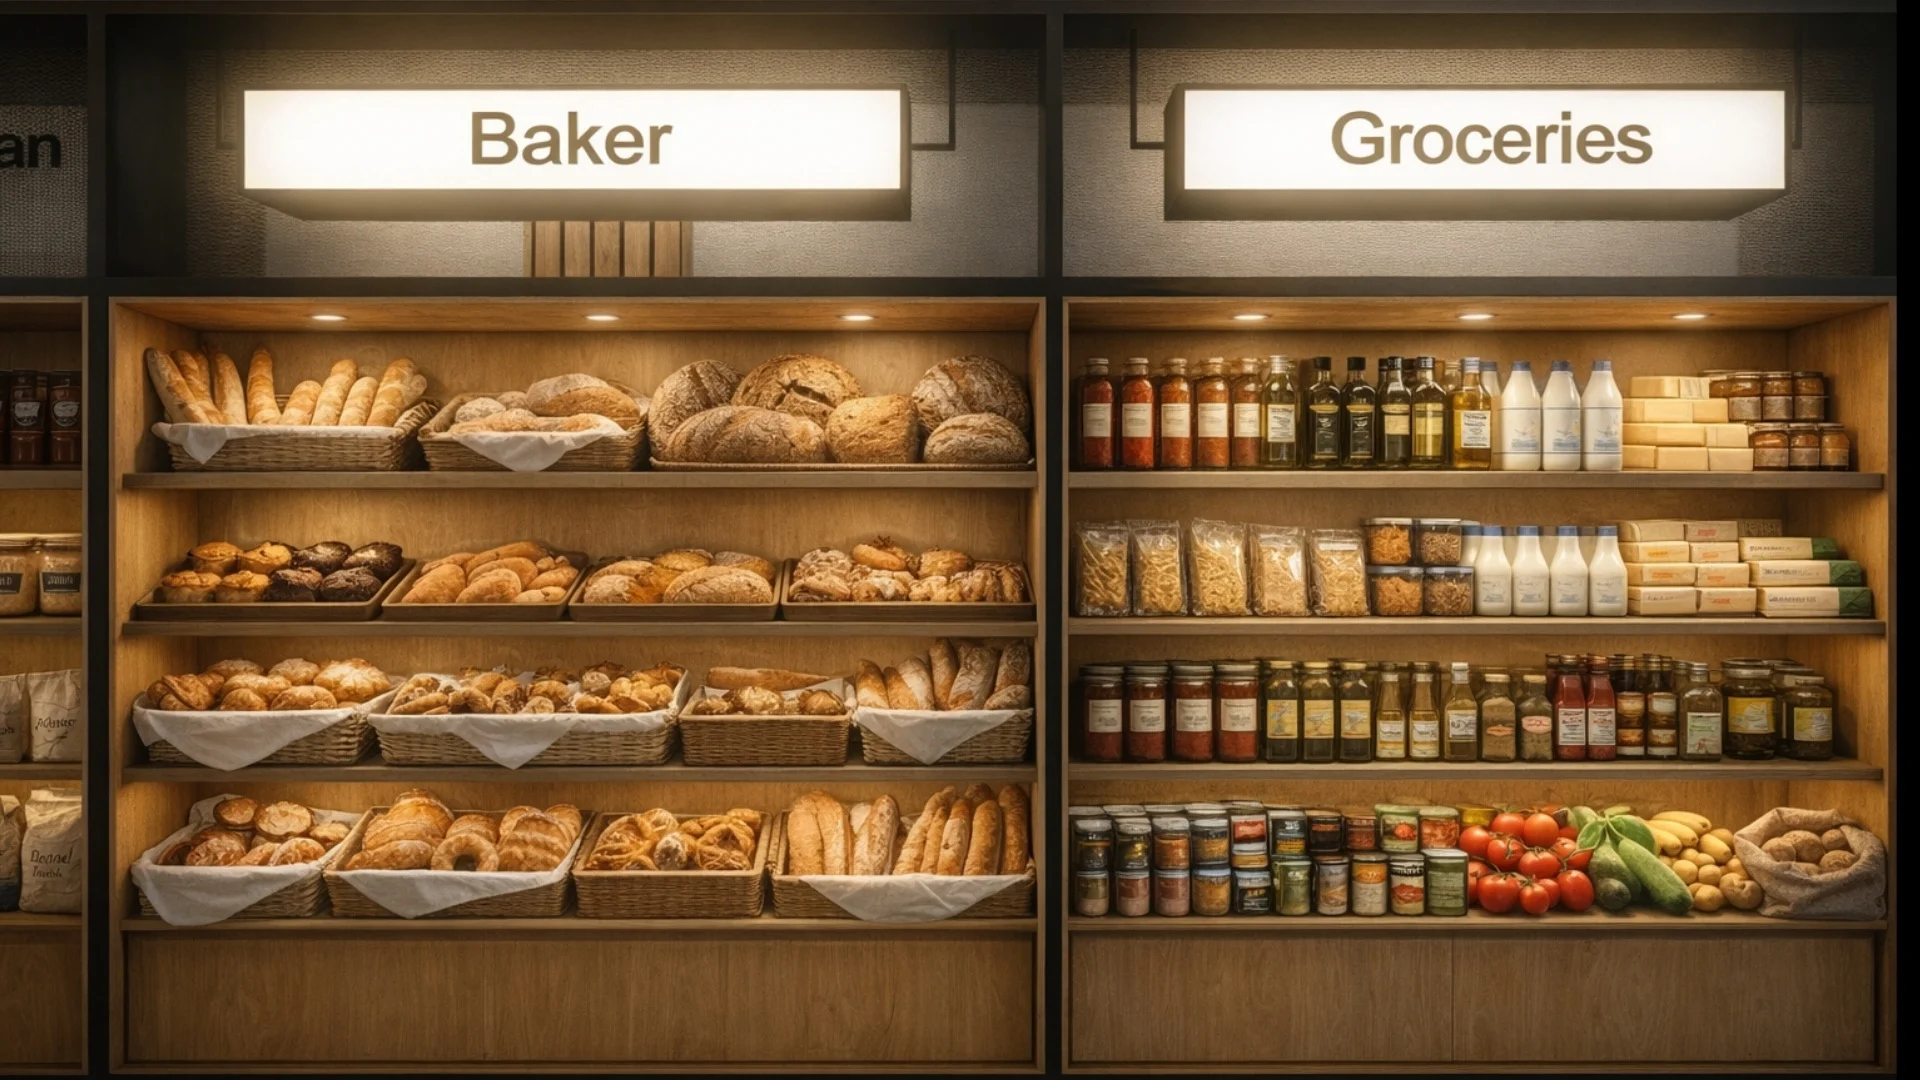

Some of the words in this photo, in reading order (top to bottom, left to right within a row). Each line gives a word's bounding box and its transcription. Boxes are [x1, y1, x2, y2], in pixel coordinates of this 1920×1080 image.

[0, 133, 61, 168] an
[471, 111, 673, 165] Baker
[1331, 110, 1653, 165] Groceries
